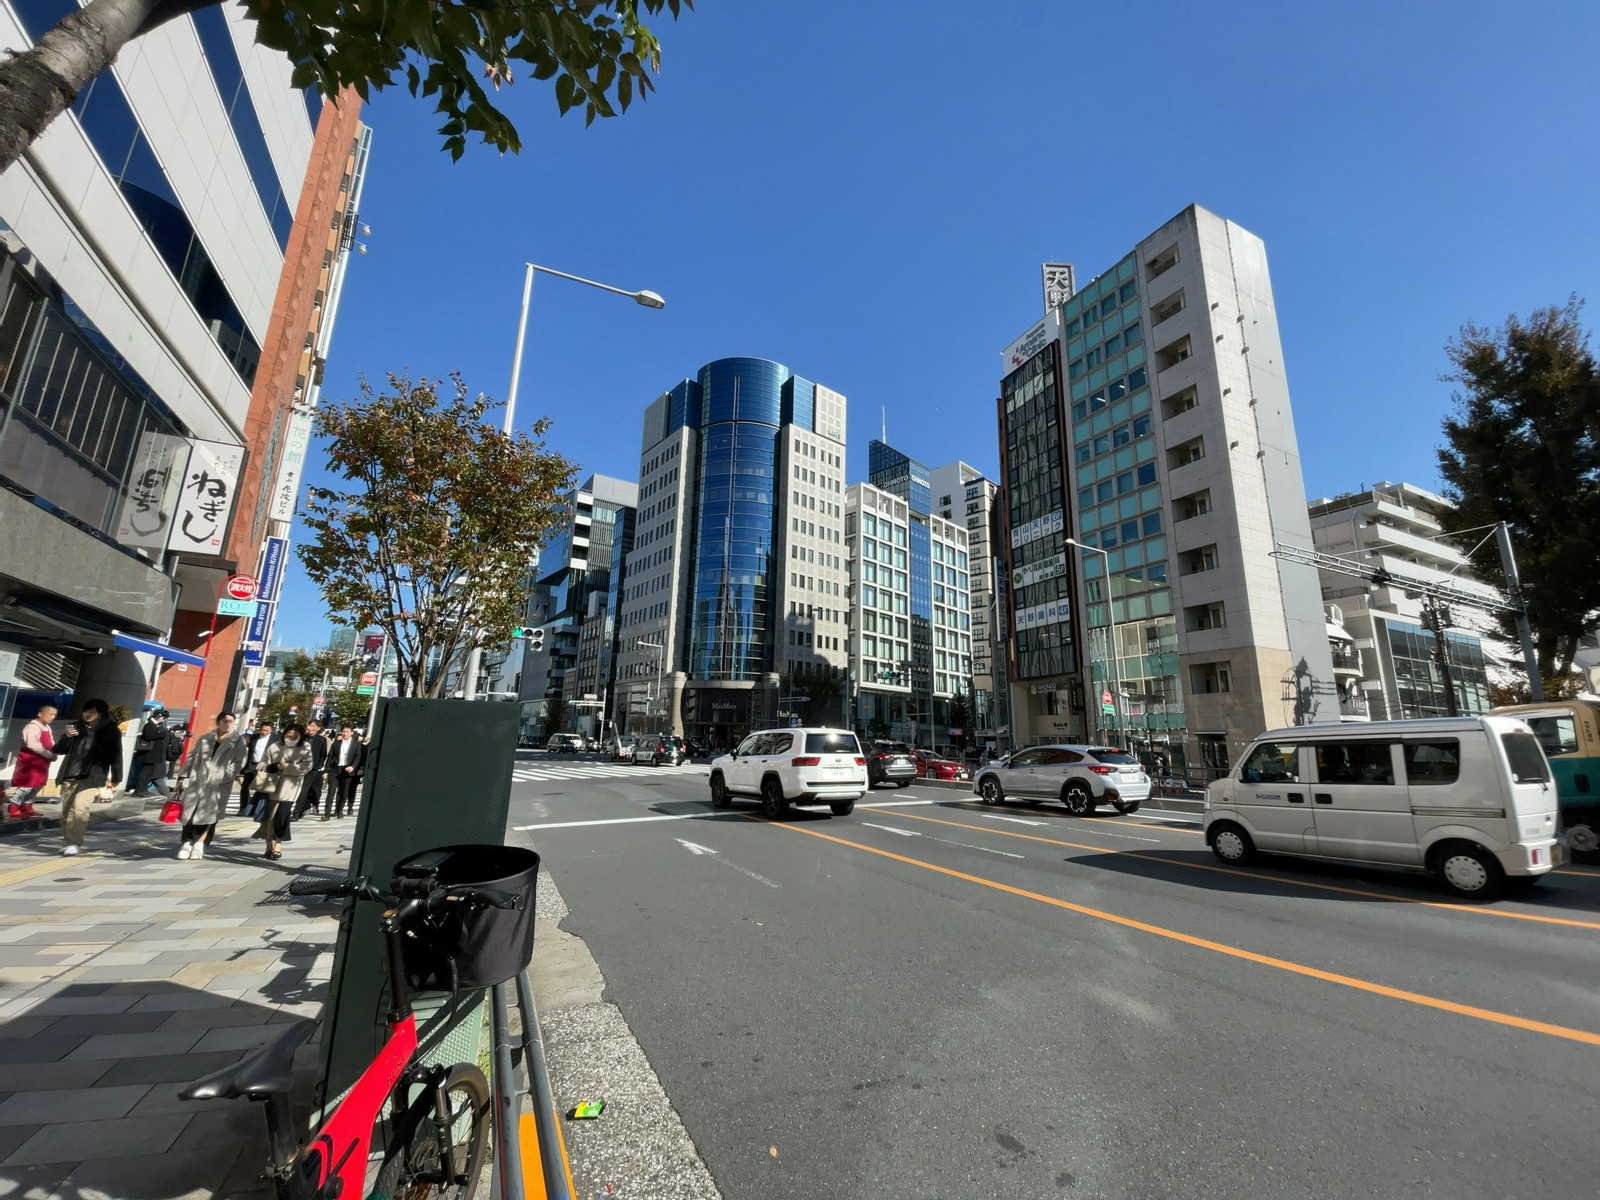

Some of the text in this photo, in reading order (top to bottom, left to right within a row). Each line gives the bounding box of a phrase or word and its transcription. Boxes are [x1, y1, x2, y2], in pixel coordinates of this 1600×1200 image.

[181, 468, 227, 544] ねぎし
[1013, 522, 1061, 547] クリニック
[262, 563, 275, 599] Matsumoto
[1056, 565, 1065, 574] 5F
[712, 702, 737, 710] MaxMara
